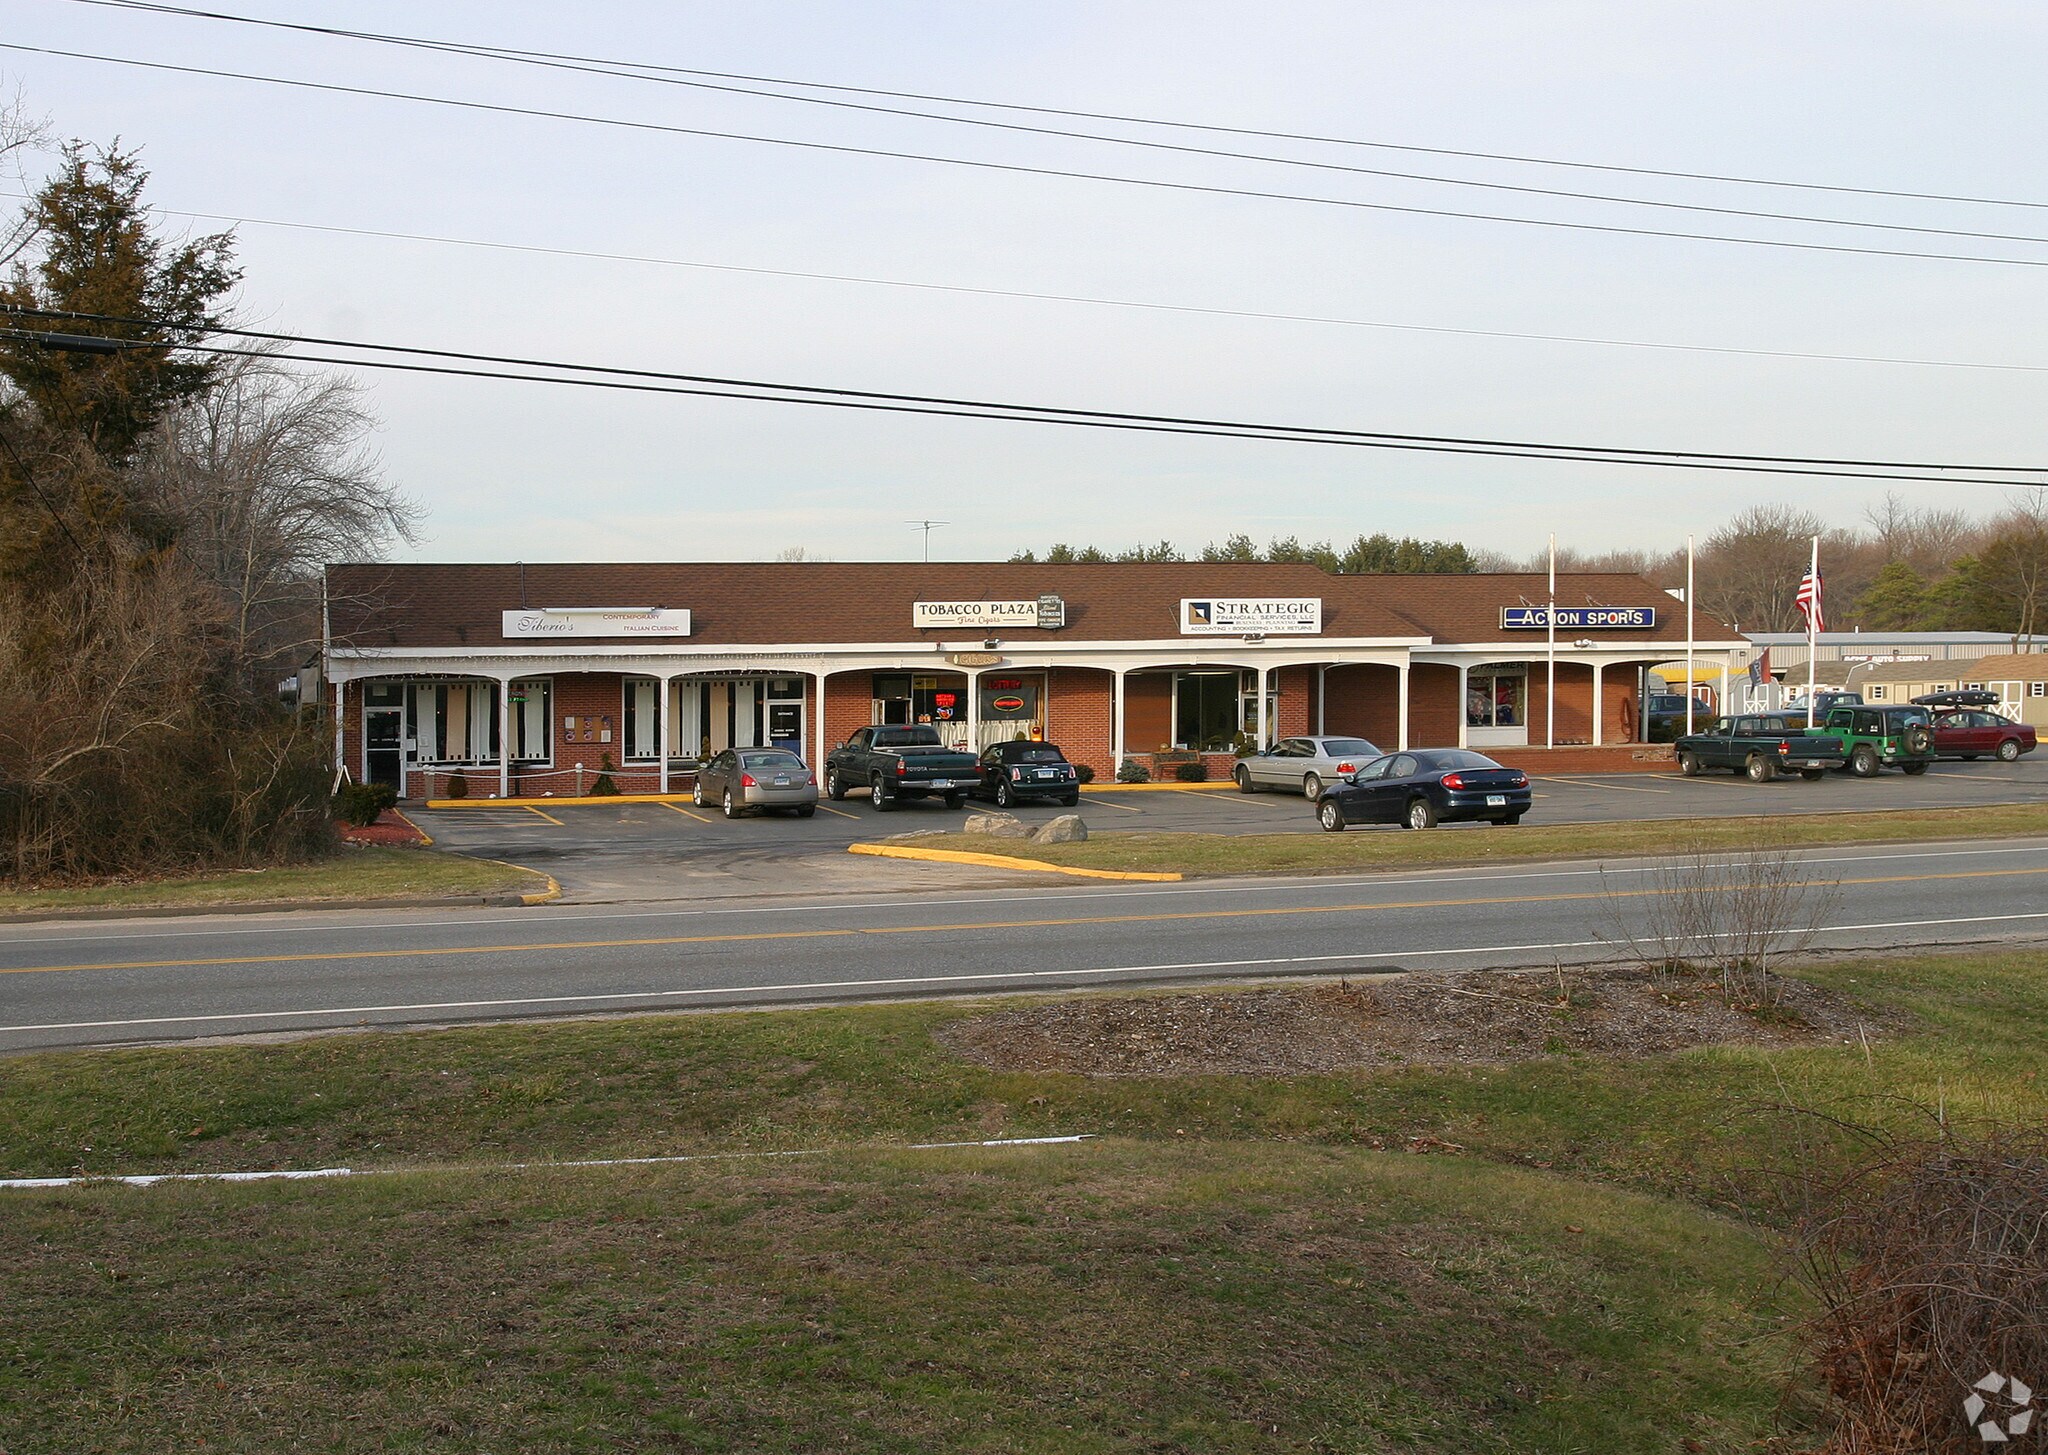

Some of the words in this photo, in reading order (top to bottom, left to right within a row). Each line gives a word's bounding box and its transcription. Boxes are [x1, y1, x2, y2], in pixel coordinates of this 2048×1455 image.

[919, 604, 982, 615] TOBACCO
[990, 604, 1035, 615] PLAZA
[1216, 601, 1315, 614] STRATEGIC
[957, 616, 975, 625] Fine
[978, 616, 1001, 625] Cigars
[1587, 609, 1643, 624] SPORTS
[517, 615, 574, 632] Tiberio's
